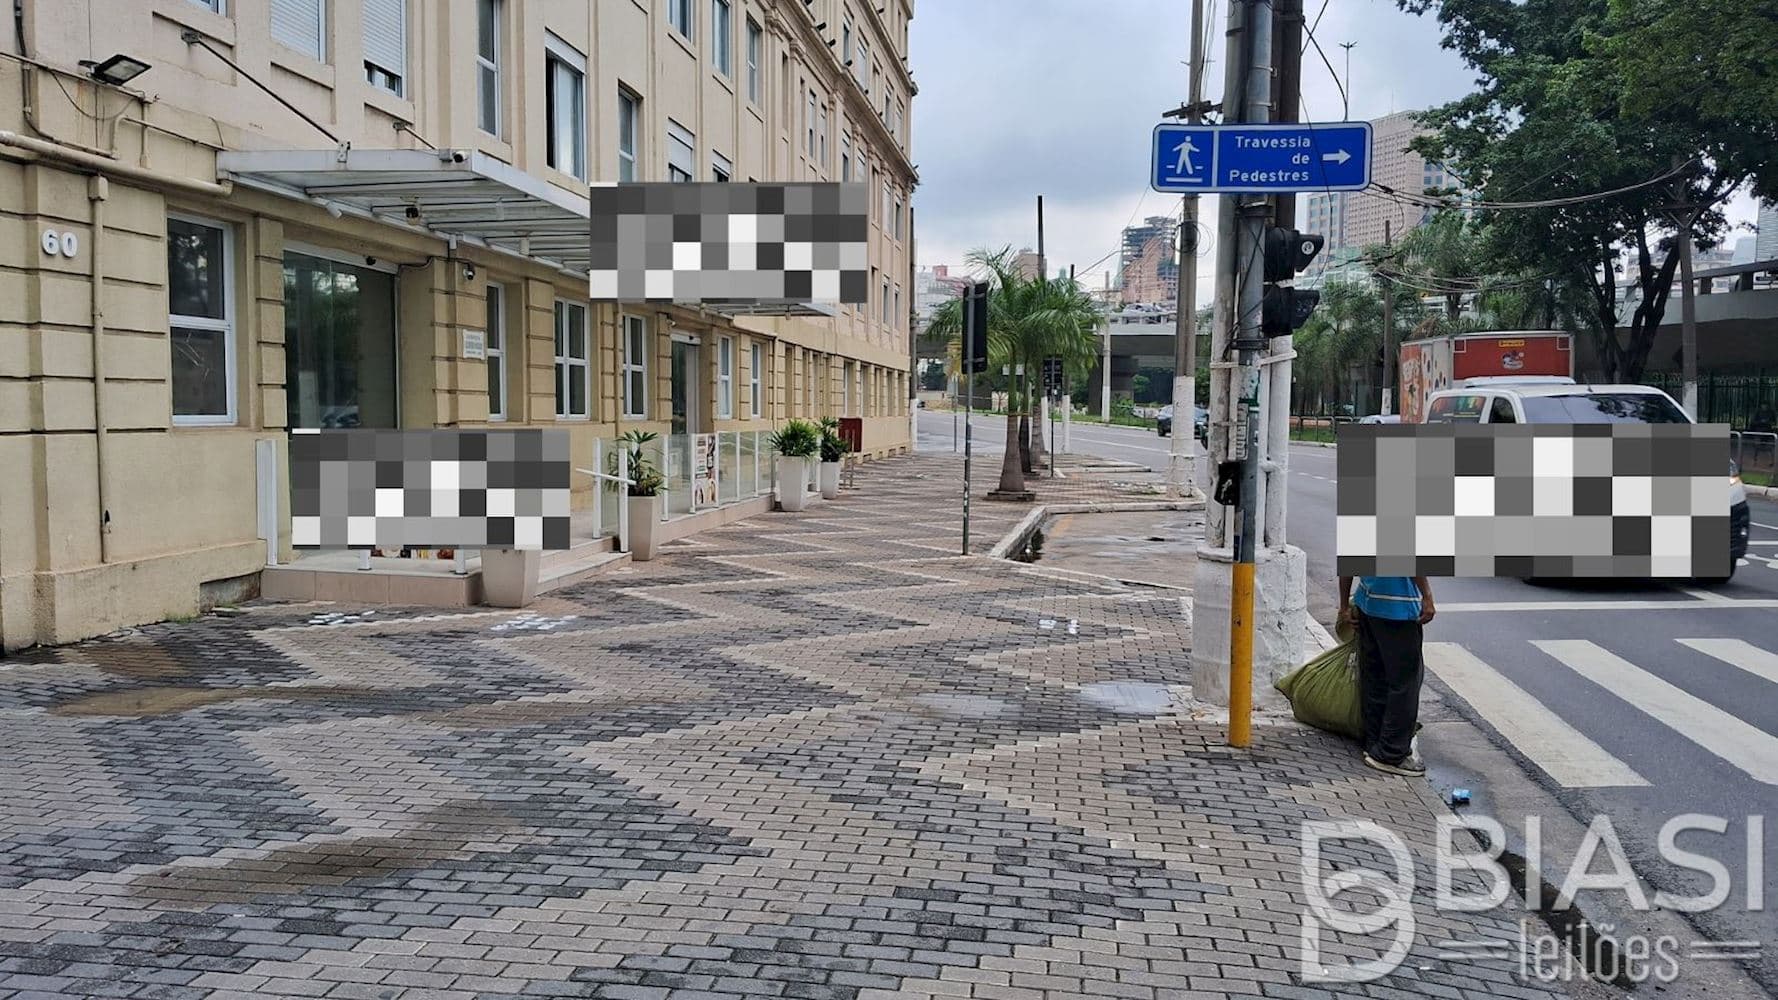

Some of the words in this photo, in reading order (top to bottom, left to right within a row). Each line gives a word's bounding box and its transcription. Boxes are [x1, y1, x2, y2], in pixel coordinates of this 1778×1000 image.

[1235, 135, 1311, 148] Travessia
[1292, 153, 1310, 165] de
[1229, 169, 1310, 182] Pedestres
[42, 229, 78, 257] 60
